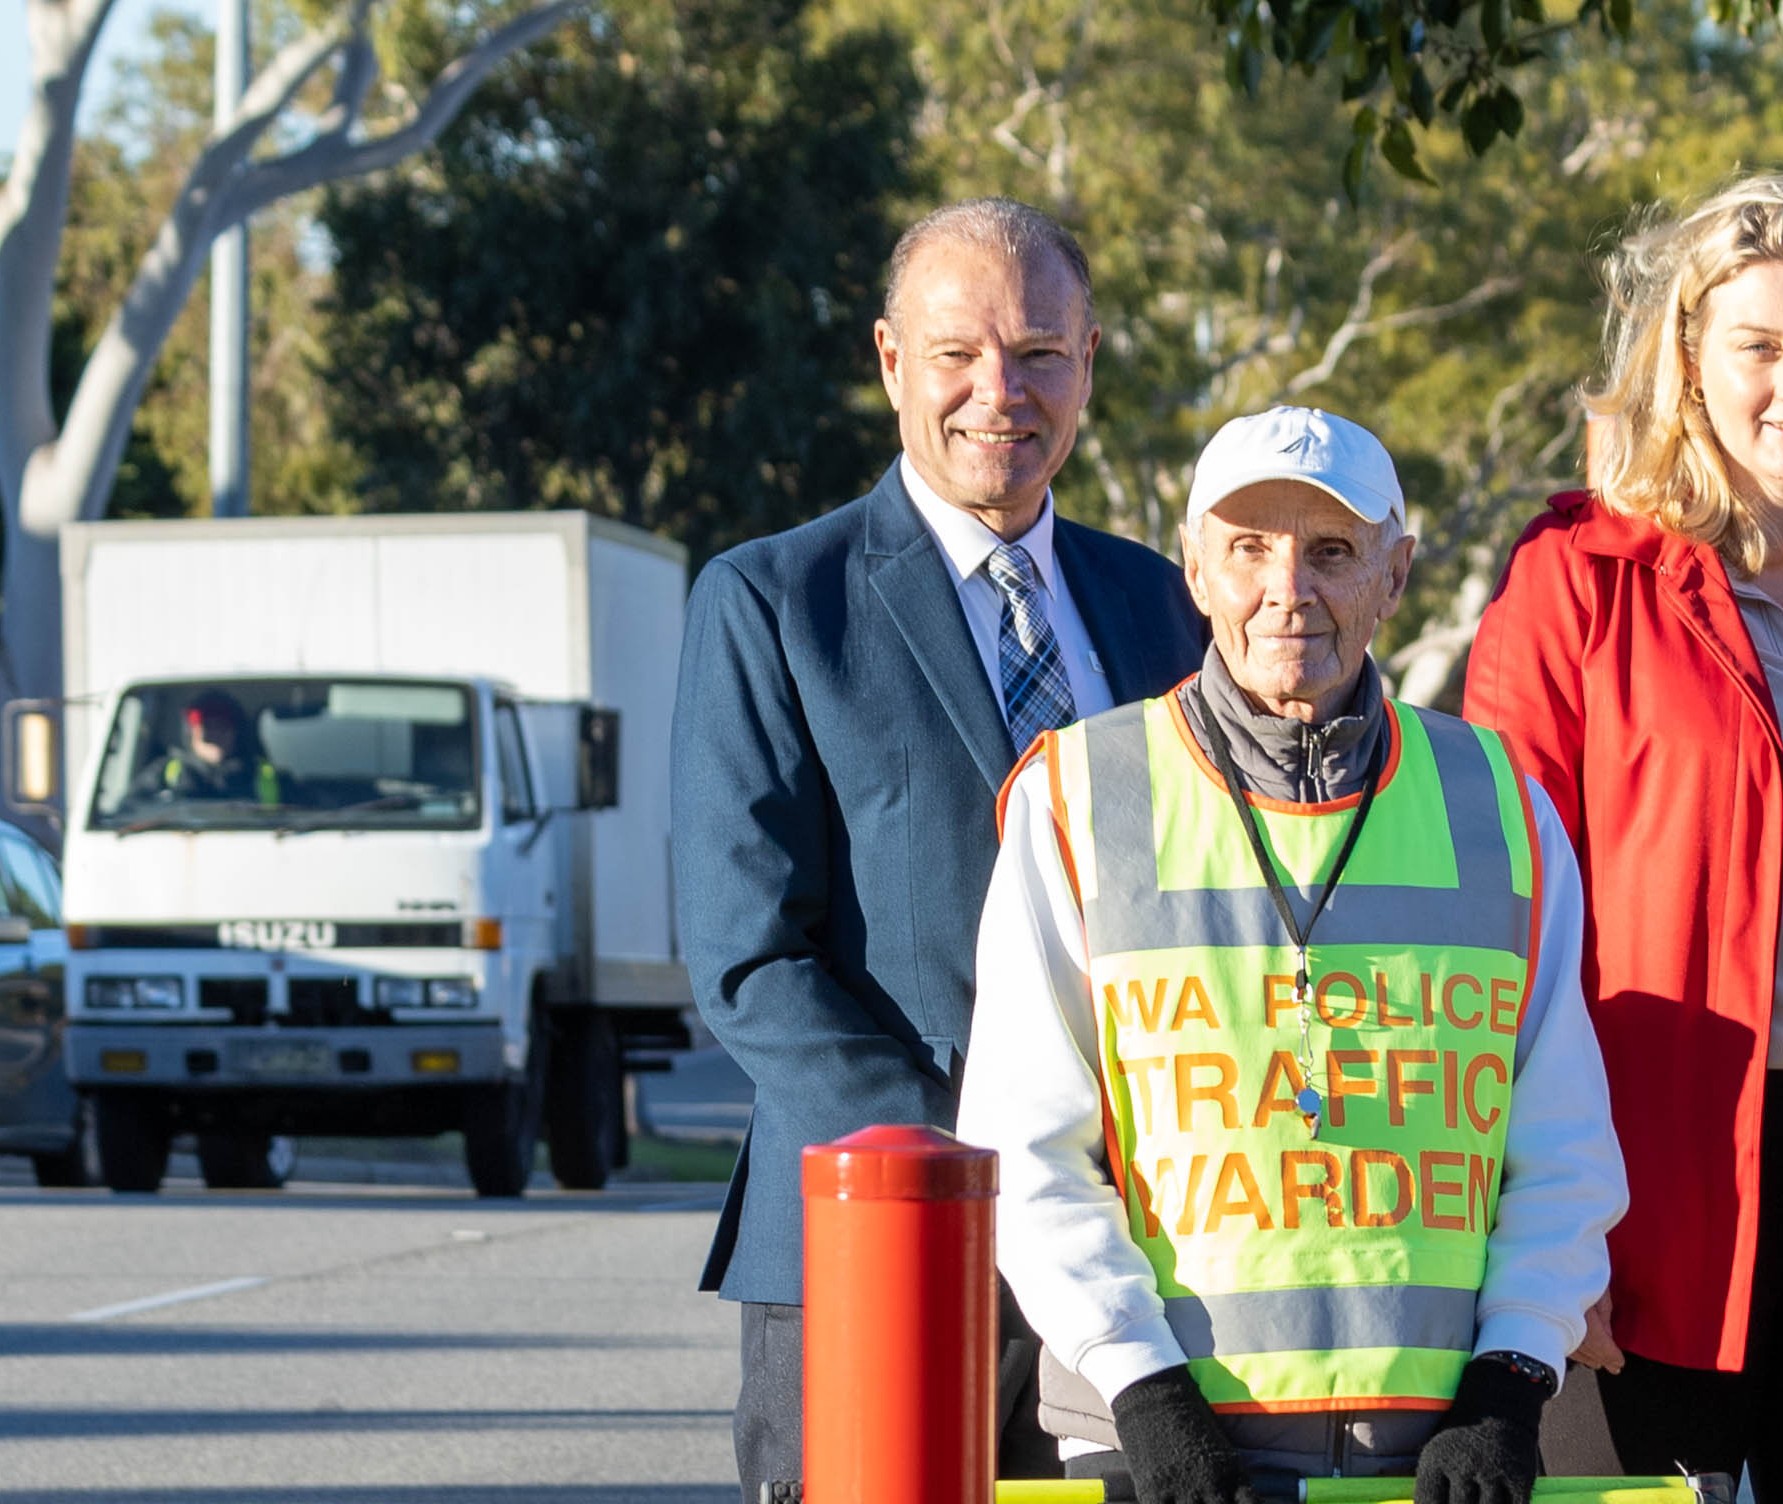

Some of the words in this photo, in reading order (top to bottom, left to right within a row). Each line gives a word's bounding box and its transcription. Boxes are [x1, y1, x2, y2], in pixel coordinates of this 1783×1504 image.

[218, 921, 336, 951] ISUZU
[1103, 975, 1220, 1033] WA
[1263, 971, 1518, 1036] POLICE
[1116, 1049, 1508, 1135] TRAFFIC
[1129, 1149, 1496, 1239] WARDEN
